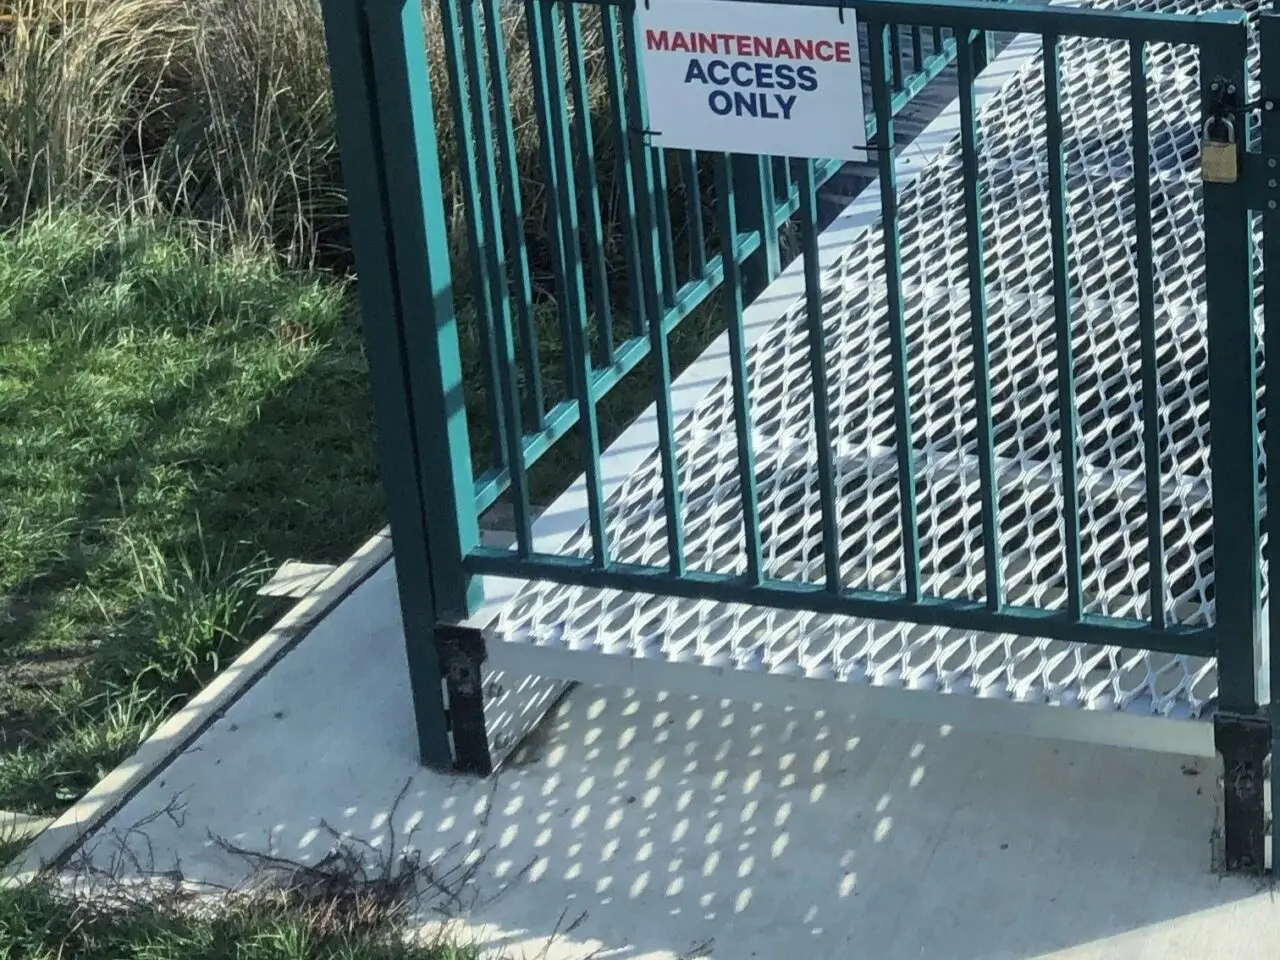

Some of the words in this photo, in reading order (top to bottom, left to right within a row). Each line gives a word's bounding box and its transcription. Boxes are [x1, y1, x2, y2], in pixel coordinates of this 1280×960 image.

[646, 29, 851, 62] MAINTENANCE
[684, 58, 818, 91] ACCESS
[708, 90, 797, 120] ONLY
